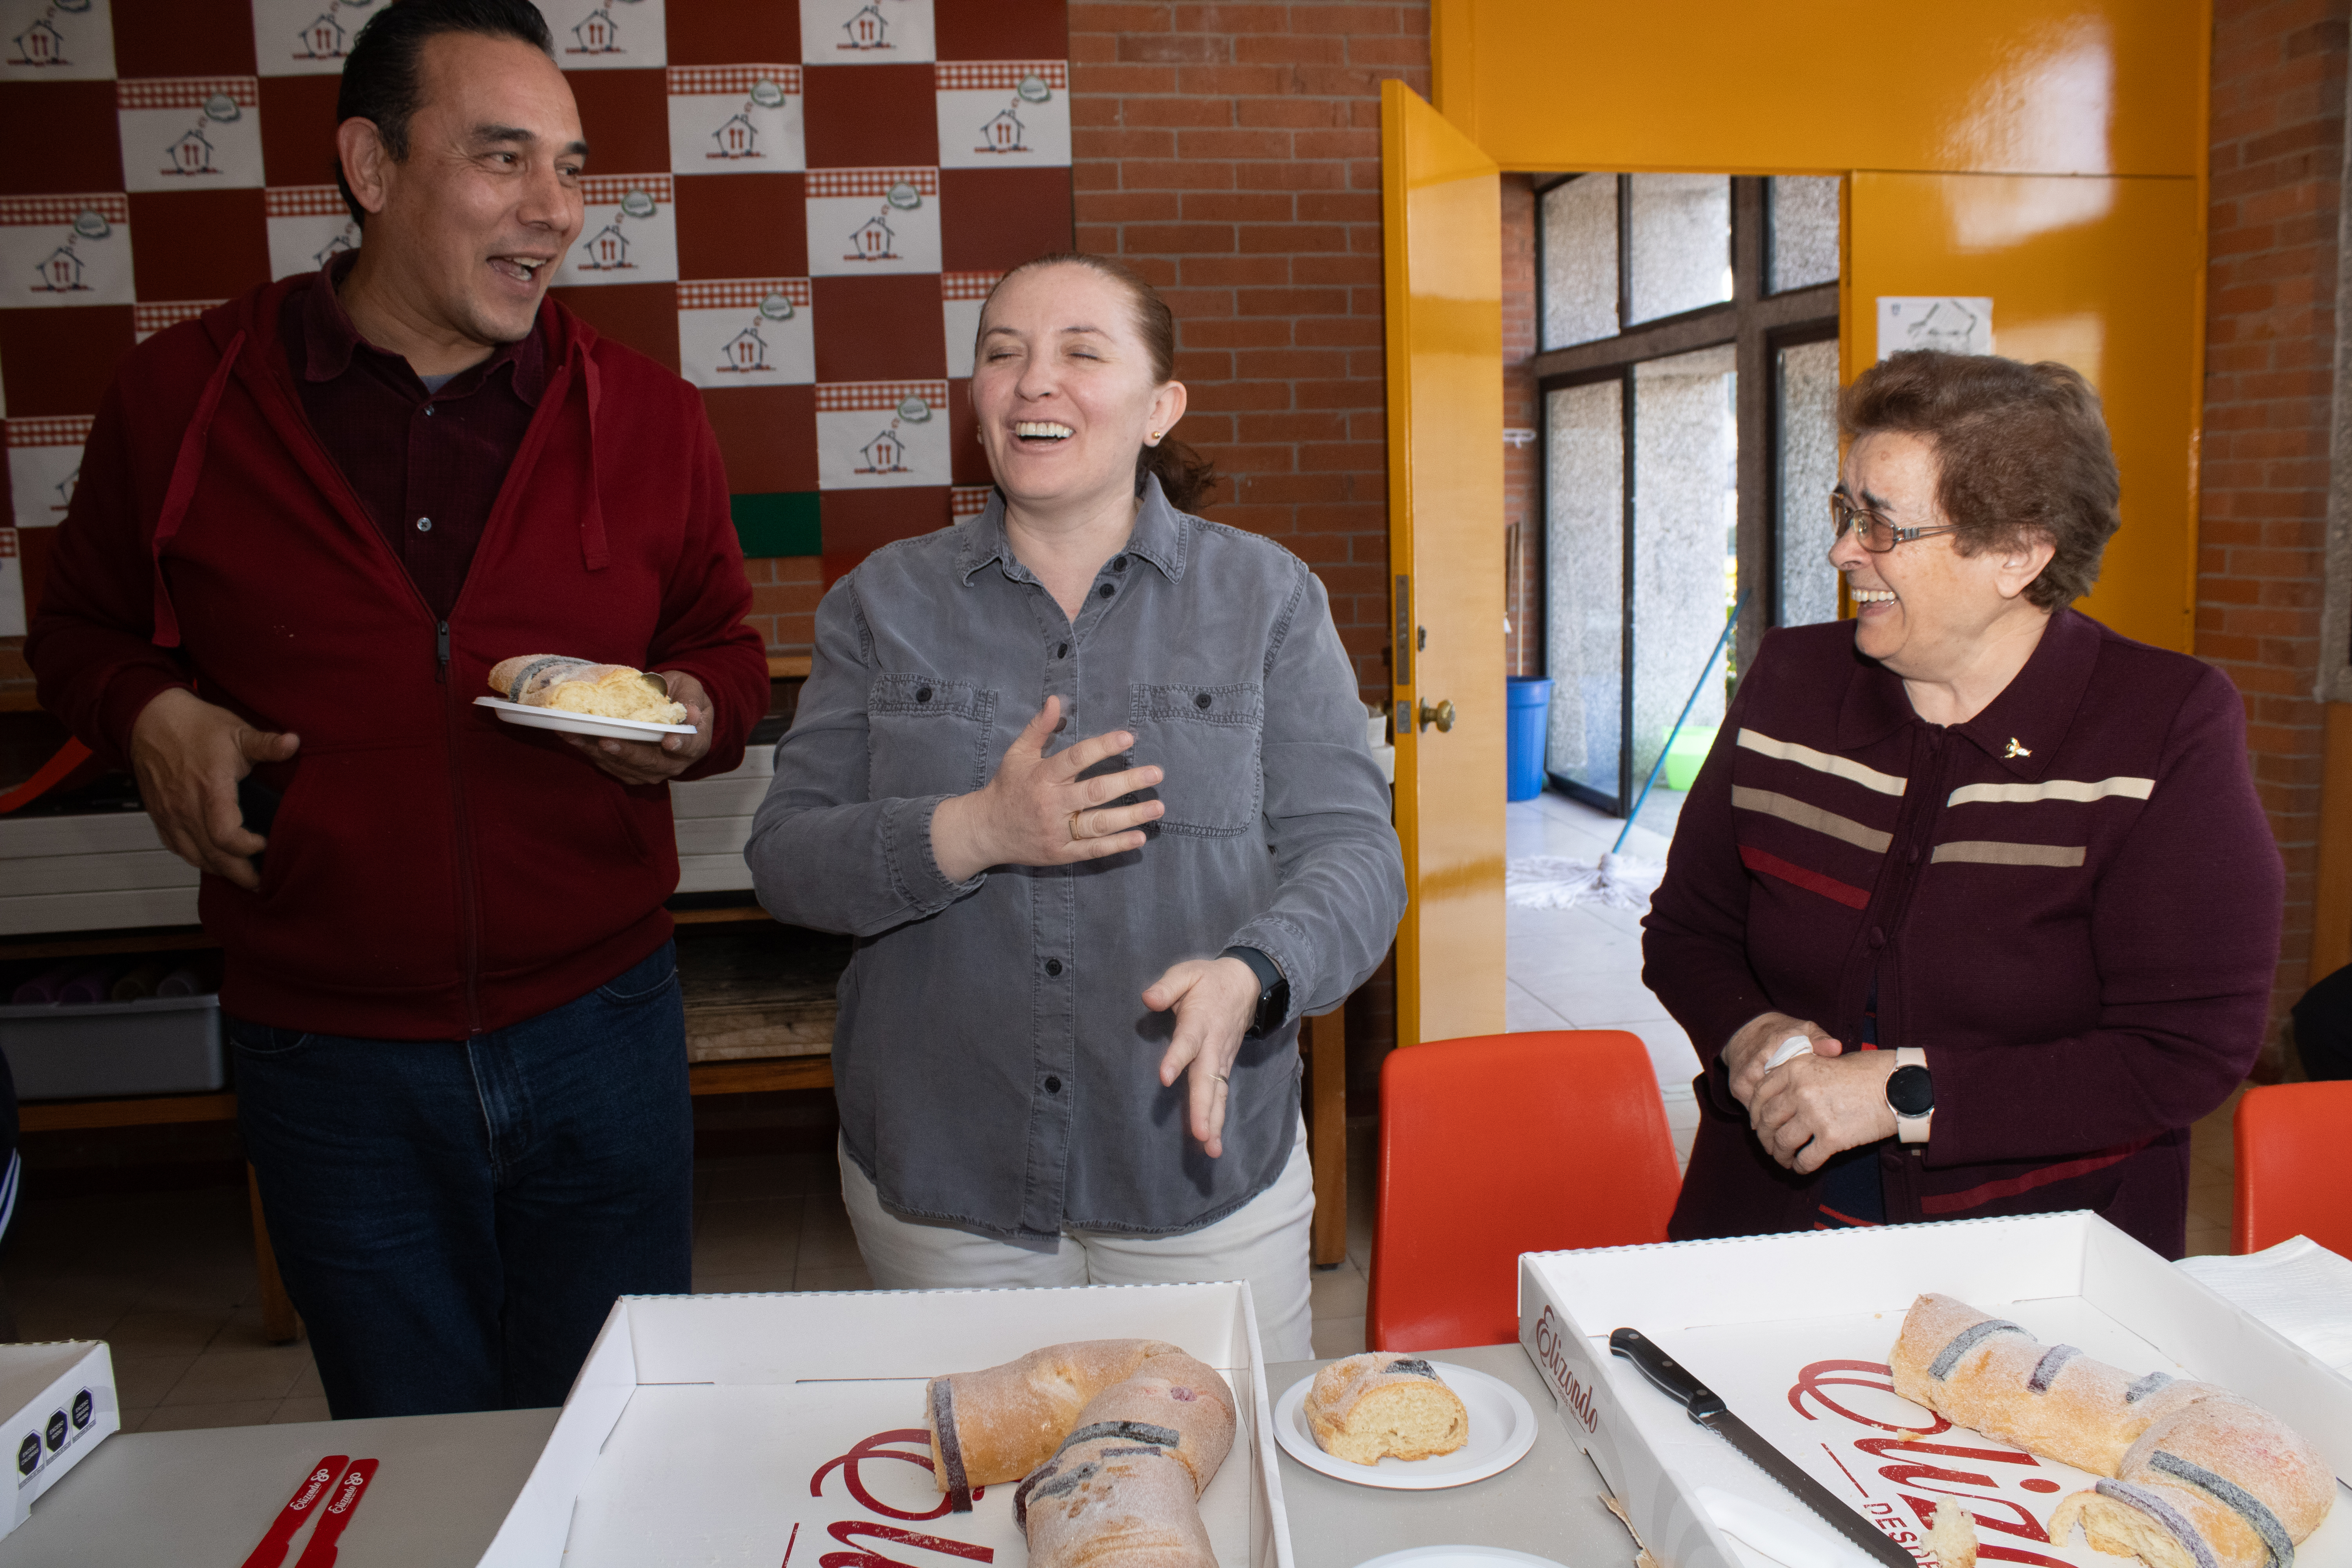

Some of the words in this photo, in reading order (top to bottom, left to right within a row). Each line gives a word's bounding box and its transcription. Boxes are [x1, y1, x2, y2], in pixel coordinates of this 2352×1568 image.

[1536, 1304, 1598, 1434] Elizondo
[75, 1399, 89, 1413] EXCESO
[49, 1420, 64, 1435] EXCESO
[51, 1427, 63, 1440] SODIO
[22, 1443, 37, 1458] EXCESO
[290, 1482, 321, 1510] Elizondo
[328, 1485, 357, 1514] Elizondo
